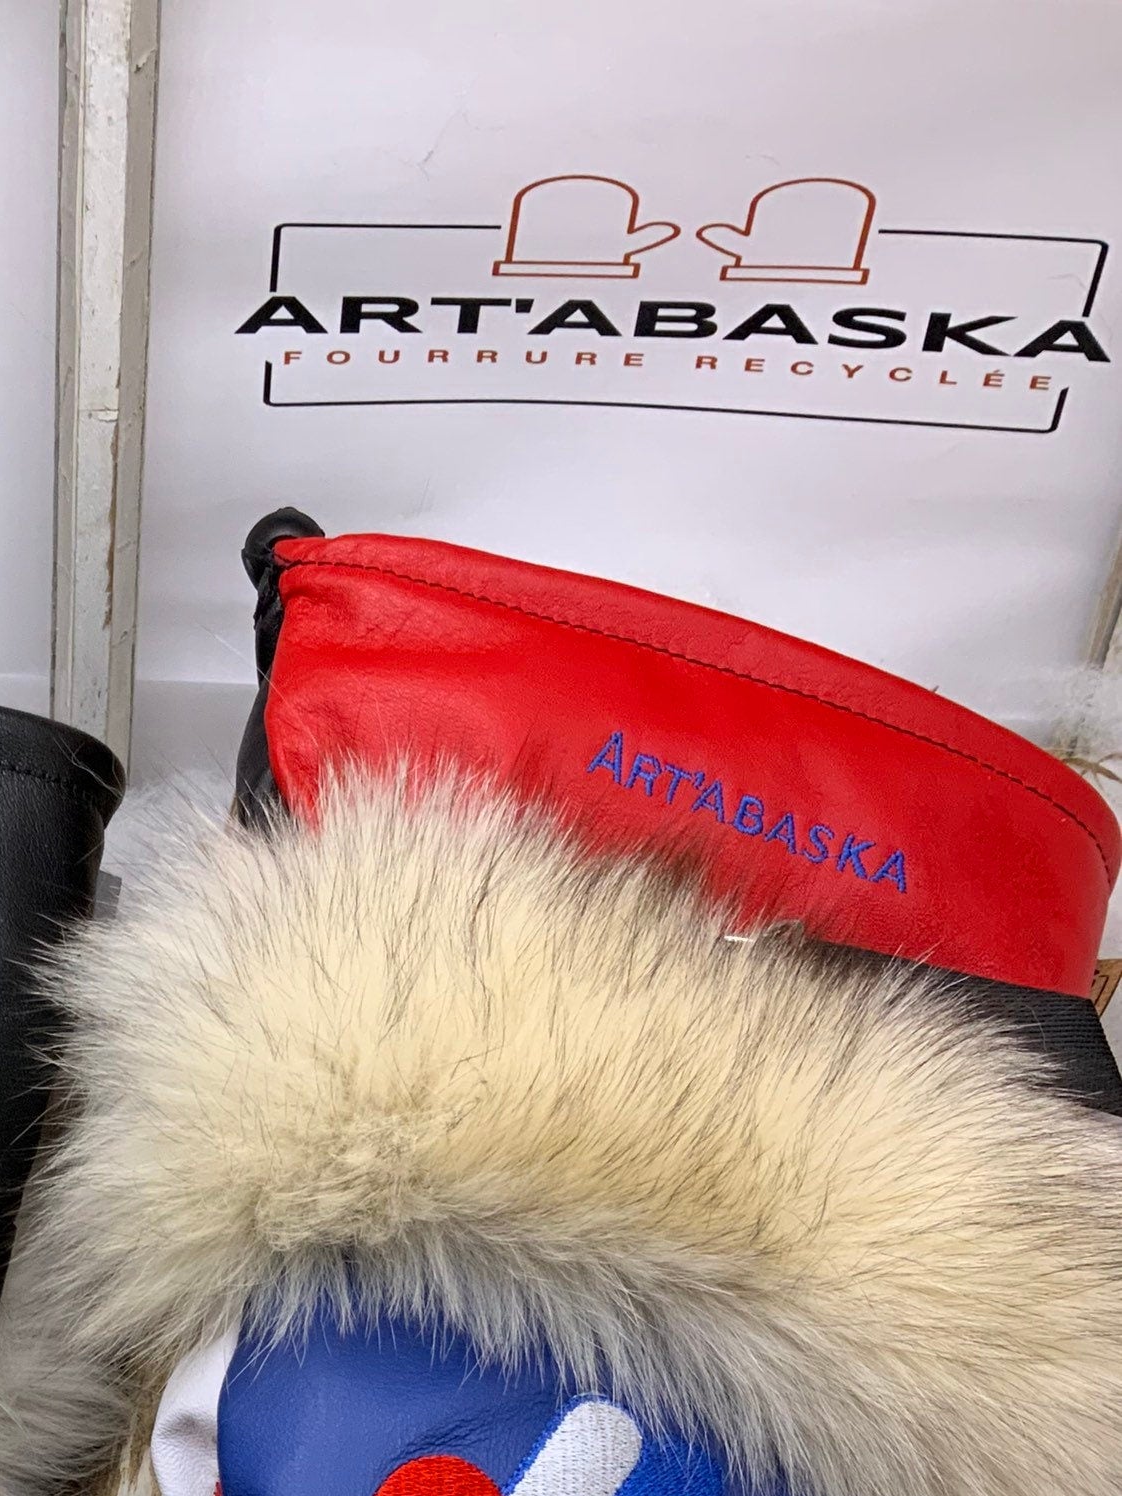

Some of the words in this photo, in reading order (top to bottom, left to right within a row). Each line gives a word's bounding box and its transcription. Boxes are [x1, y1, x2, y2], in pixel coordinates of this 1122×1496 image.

[235, 297, 1110, 362] ART'ABASKA
[282, 350, 644, 367] FOURRURE
[694, 354, 1053, 392] RECYCLÉE
[587, 730, 907, 894] ART'ABASKA
